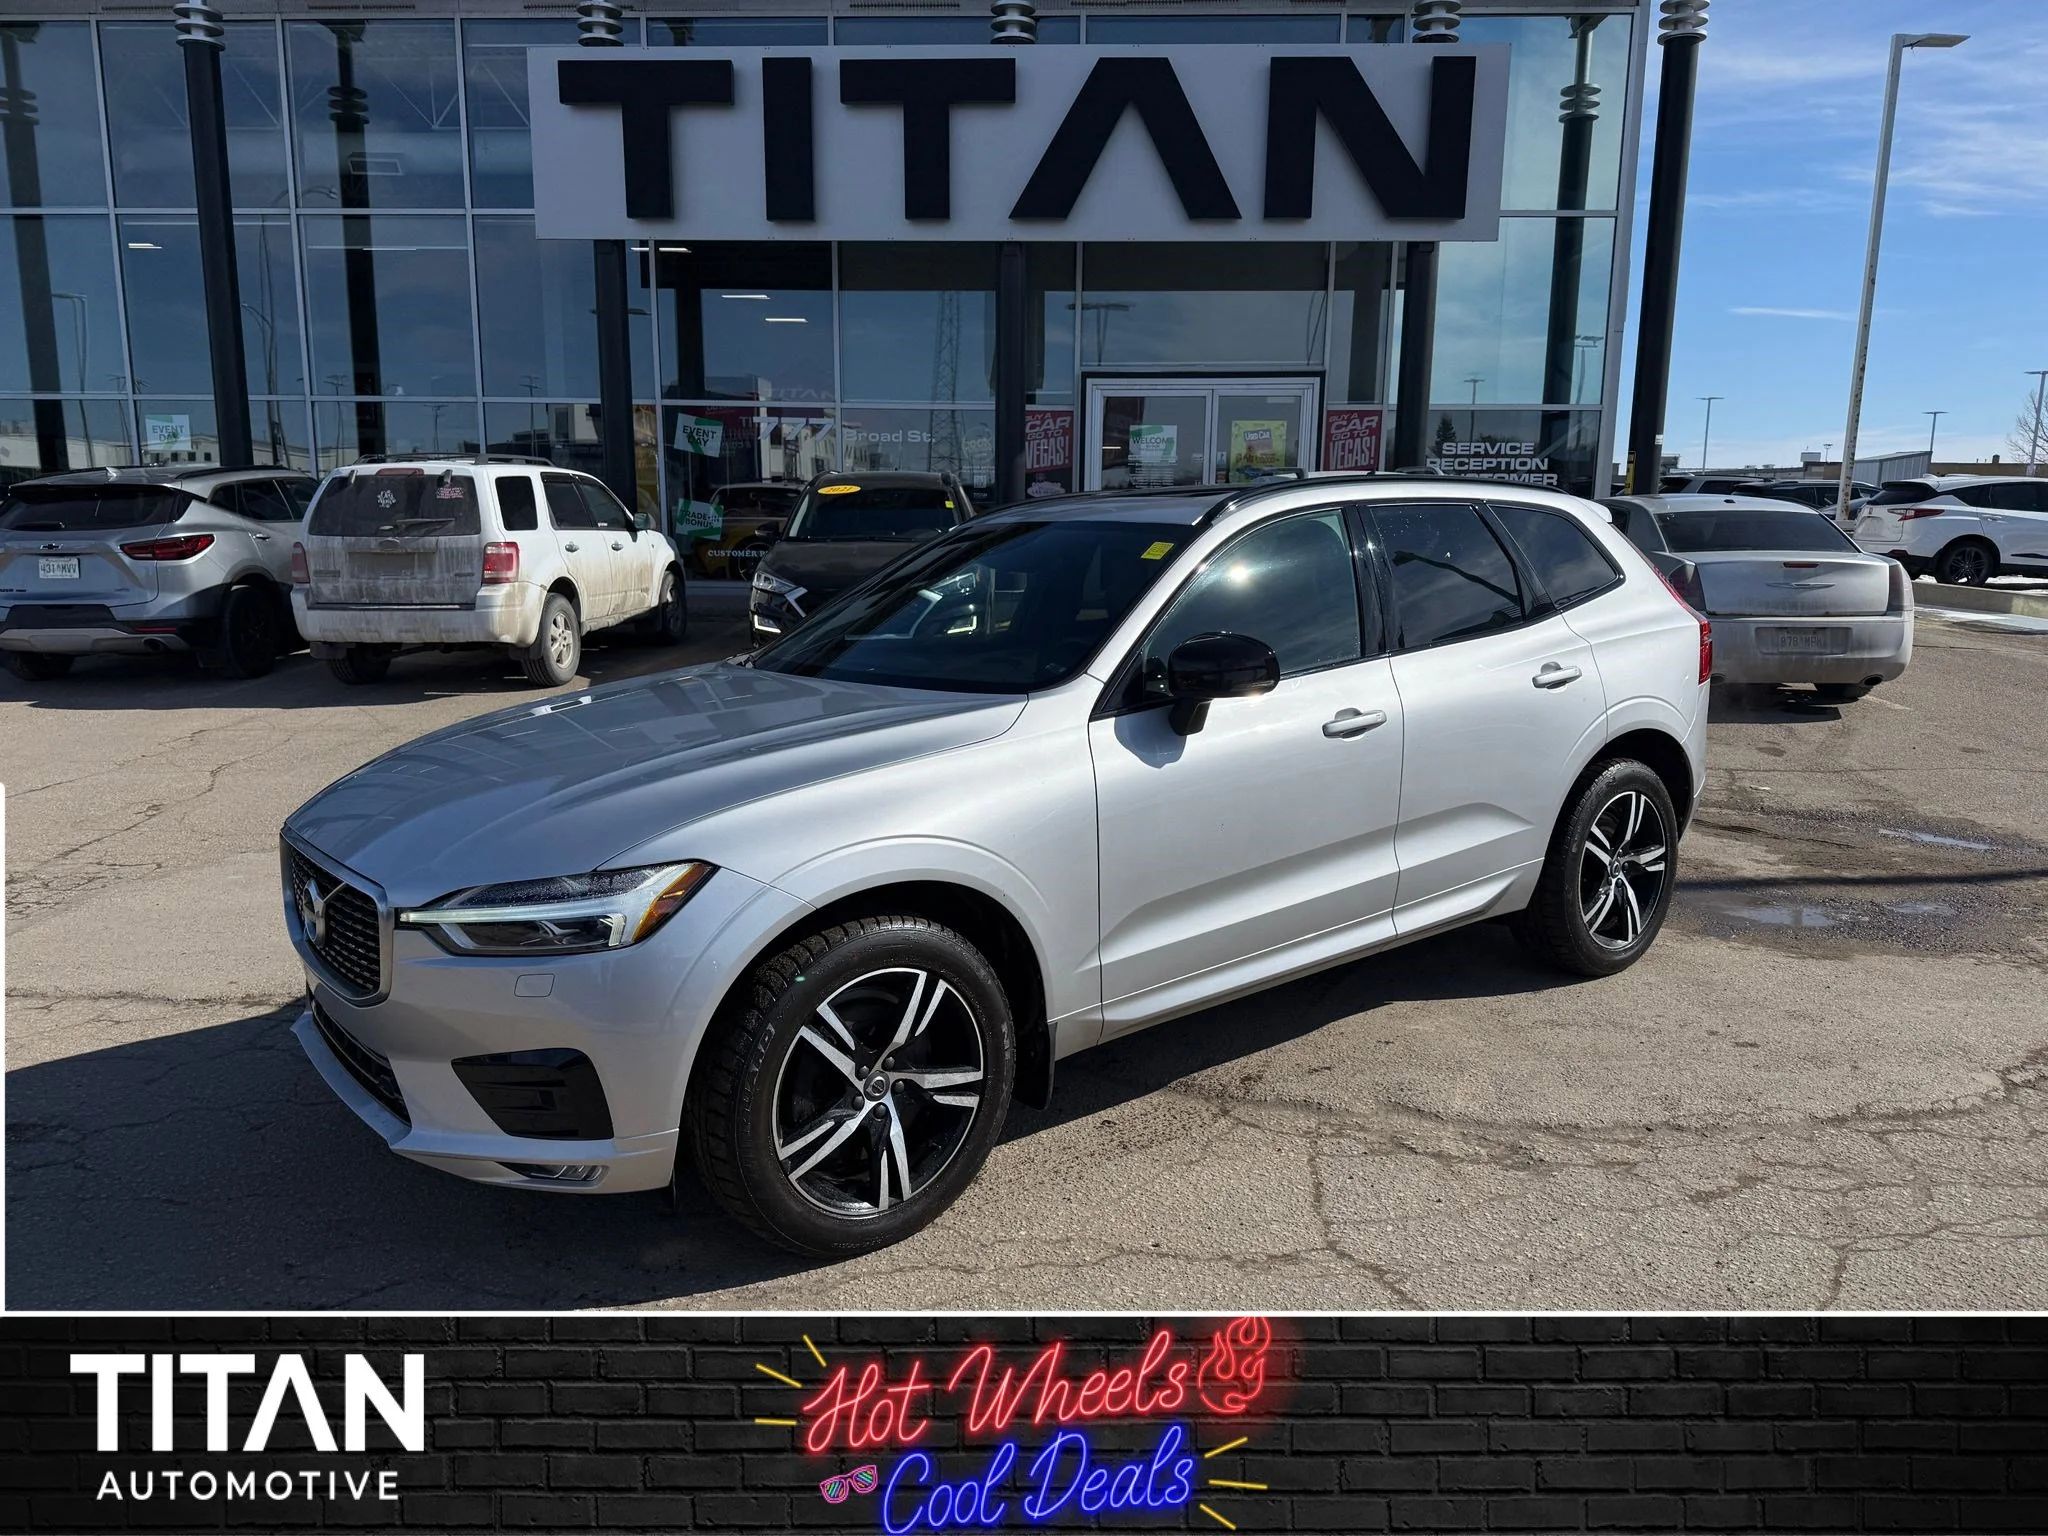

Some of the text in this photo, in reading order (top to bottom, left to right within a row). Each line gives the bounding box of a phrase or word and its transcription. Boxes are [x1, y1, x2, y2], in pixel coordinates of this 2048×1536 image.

[558, 55, 1476, 221] TITAN
[1328, 414, 1350, 422] BUY
[152, 425, 185, 434] EVENT
[753, 417, 835, 441] 777
[843, 429, 904, 443] Broad
[907, 429, 936, 443] St.
[1025, 416, 1071, 433] CAR
[1330, 416, 1378, 433] CAR
[682, 425, 717, 439] EVENT
[1027, 429, 1063, 440] GO TO
[1332, 429, 1370, 440] GO TO
[1132, 436, 1174, 445] WELCOM
[1025, 435, 1069, 469] VEGAS!
[1329, 436, 1376, 470] VEGAS!
[1442, 442, 1535, 455] SERVICE
[1426, 458, 1548, 470] RECEPTION
[685, 517, 713, 529] BONUS
[707, 549, 757, 557] CUSTOMER
